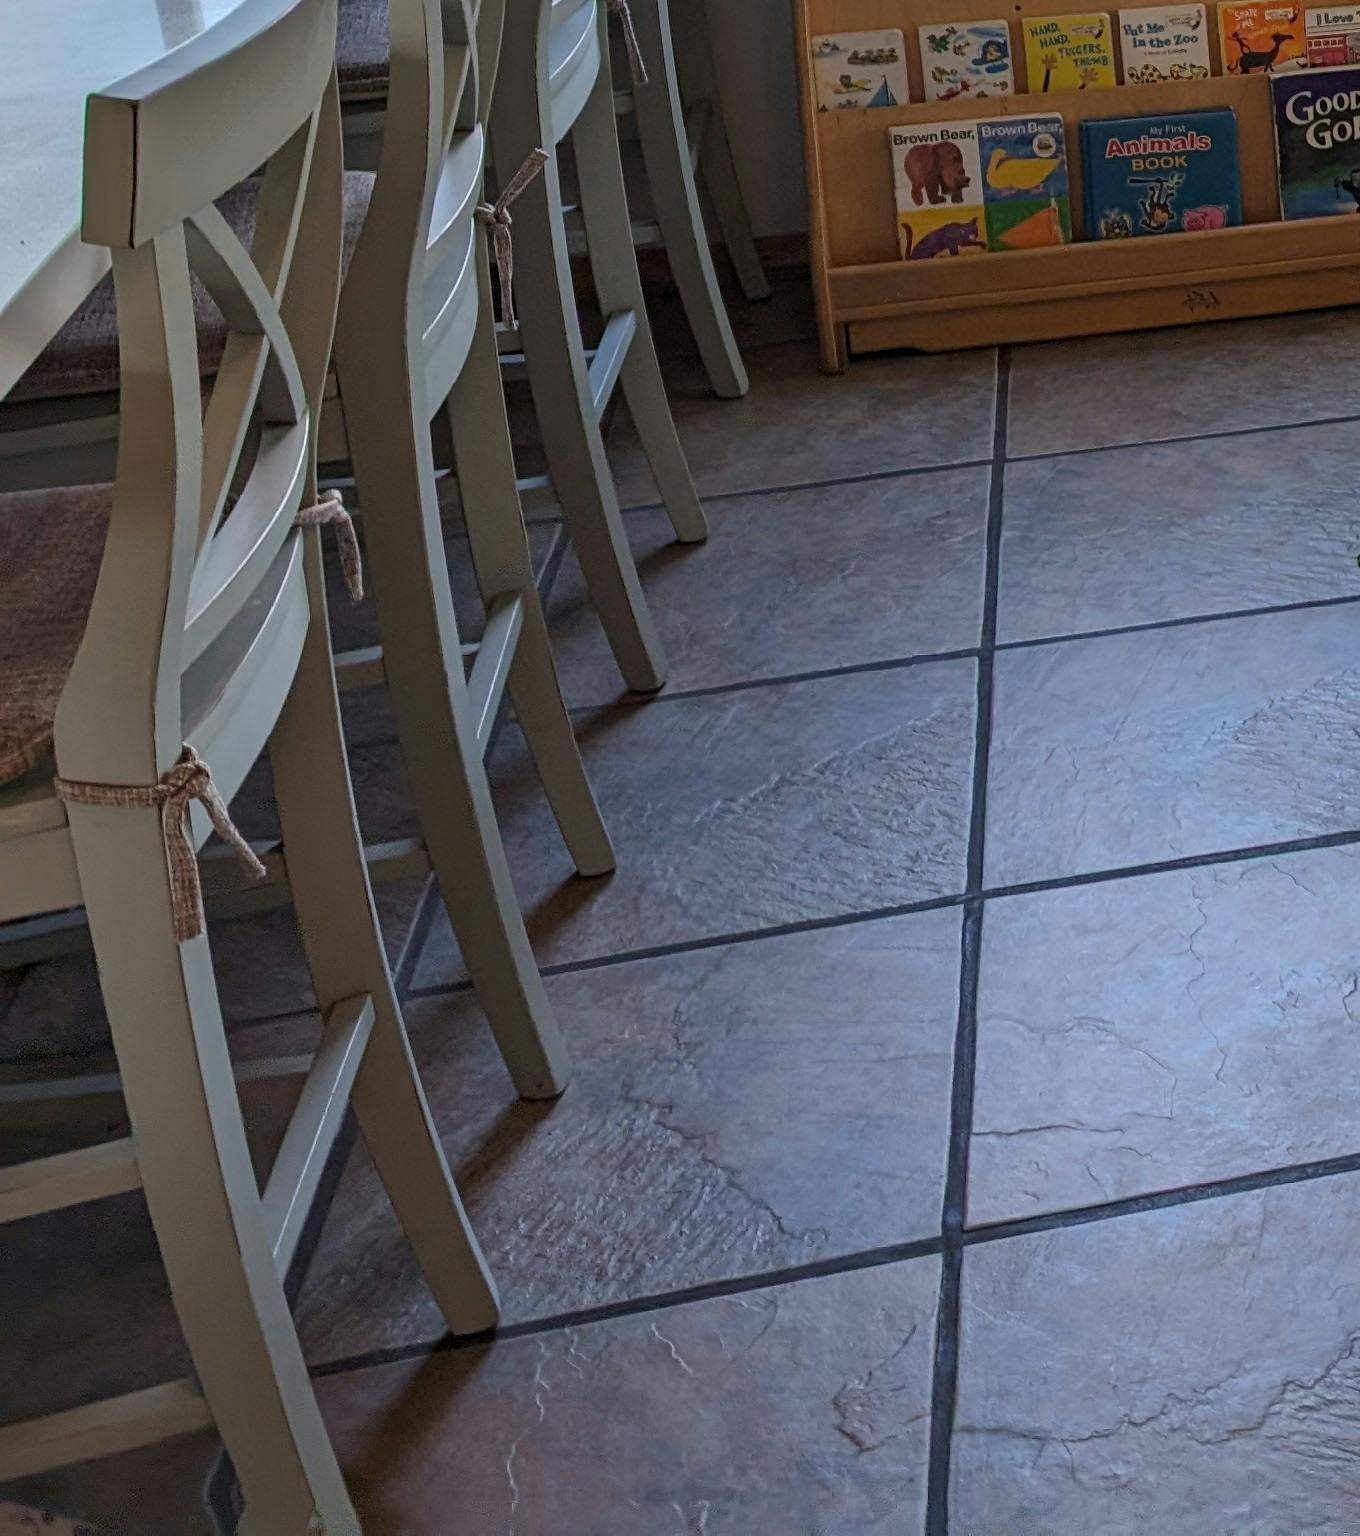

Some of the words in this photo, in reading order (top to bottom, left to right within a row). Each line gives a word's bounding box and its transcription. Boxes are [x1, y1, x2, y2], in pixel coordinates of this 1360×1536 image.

[1316, 14, 1322, 25] I
[1324, 12, 1354, 24] Love
[1122, 23, 1144, 36] Put
[1146, 22, 1164, 34] Me
[1132, 36, 1146, 48] in
[1150, 36, 1171, 48] the
[1173, 33, 1198, 45] Zoo
[1073, 55, 1108, 68] THUMB
[981, 124, 1026, 138] Brown
[1028, 121, 1063, 134] Bear,
[1150, 126, 1162, 136] My
[1166, 124, 1186, 135] First
[893, 132, 938, 146] Brown
[940, 129, 976, 141] Bear,
[1105, 131, 1212, 158] Animals
[1132, 154, 1188, 172] BOOK
